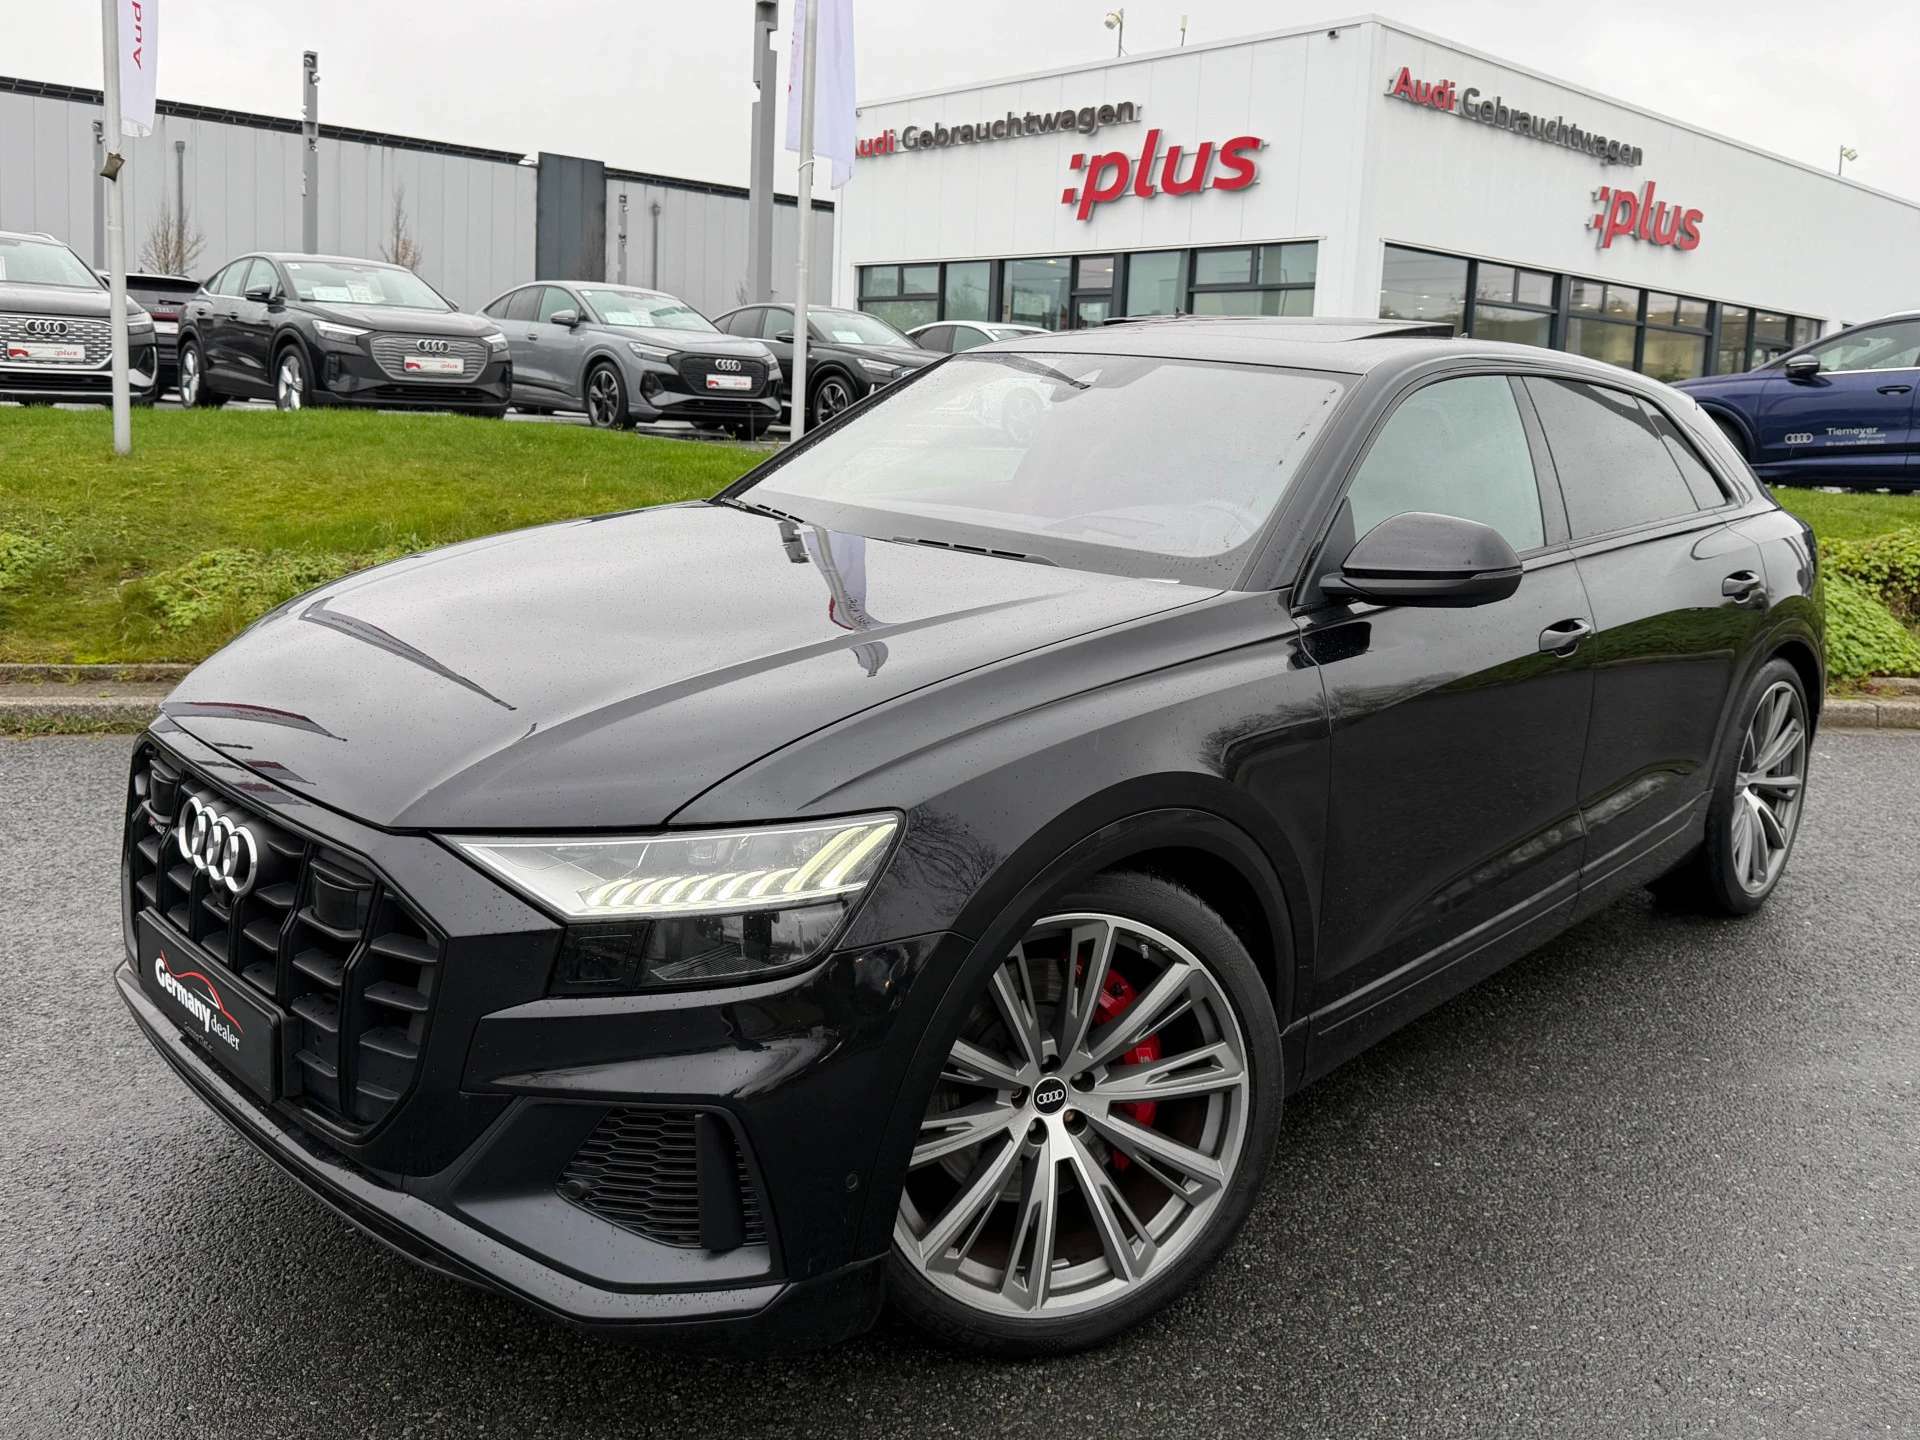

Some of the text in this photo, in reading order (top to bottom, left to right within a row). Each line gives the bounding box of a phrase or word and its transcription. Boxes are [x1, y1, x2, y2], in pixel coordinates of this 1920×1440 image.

[131, 0, 142, 71] Aud
[901, 100, 1135, 151] Gebrauchtwagen
[1390, 66, 1643, 166] Audi Gebrauchtwagen
[155, 957, 211, 1033] Germany
[210, 1014, 240, 1051] dealer
